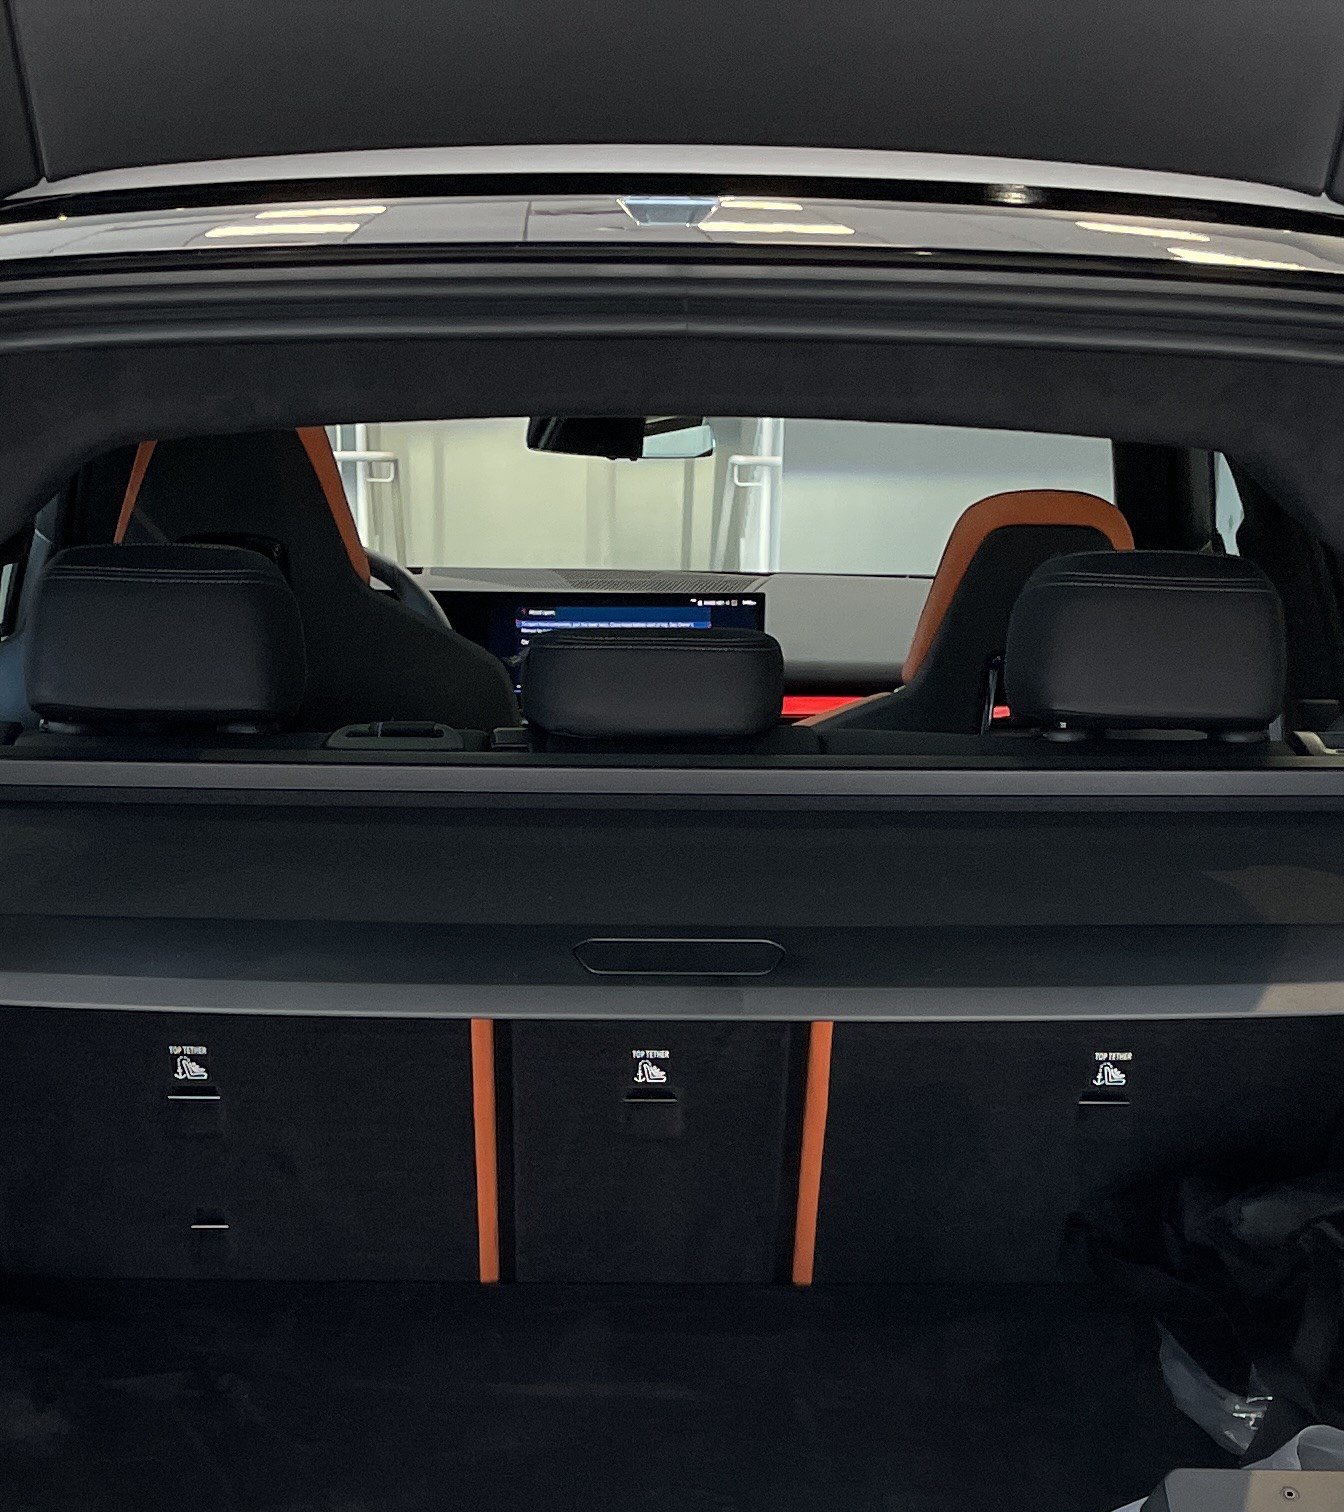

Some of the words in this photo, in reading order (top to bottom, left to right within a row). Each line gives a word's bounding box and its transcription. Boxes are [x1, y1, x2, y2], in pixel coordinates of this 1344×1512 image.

[168, 1045, 182, 1055] TOP
[182, 1045, 207, 1055] TETHER
[632, 1049, 645, 1059] TOP
[645, 1049, 670, 1059] TETHER
[1095, 1051, 1108, 1061] TOP
[1109, 1051, 1133, 1061] TETHER
